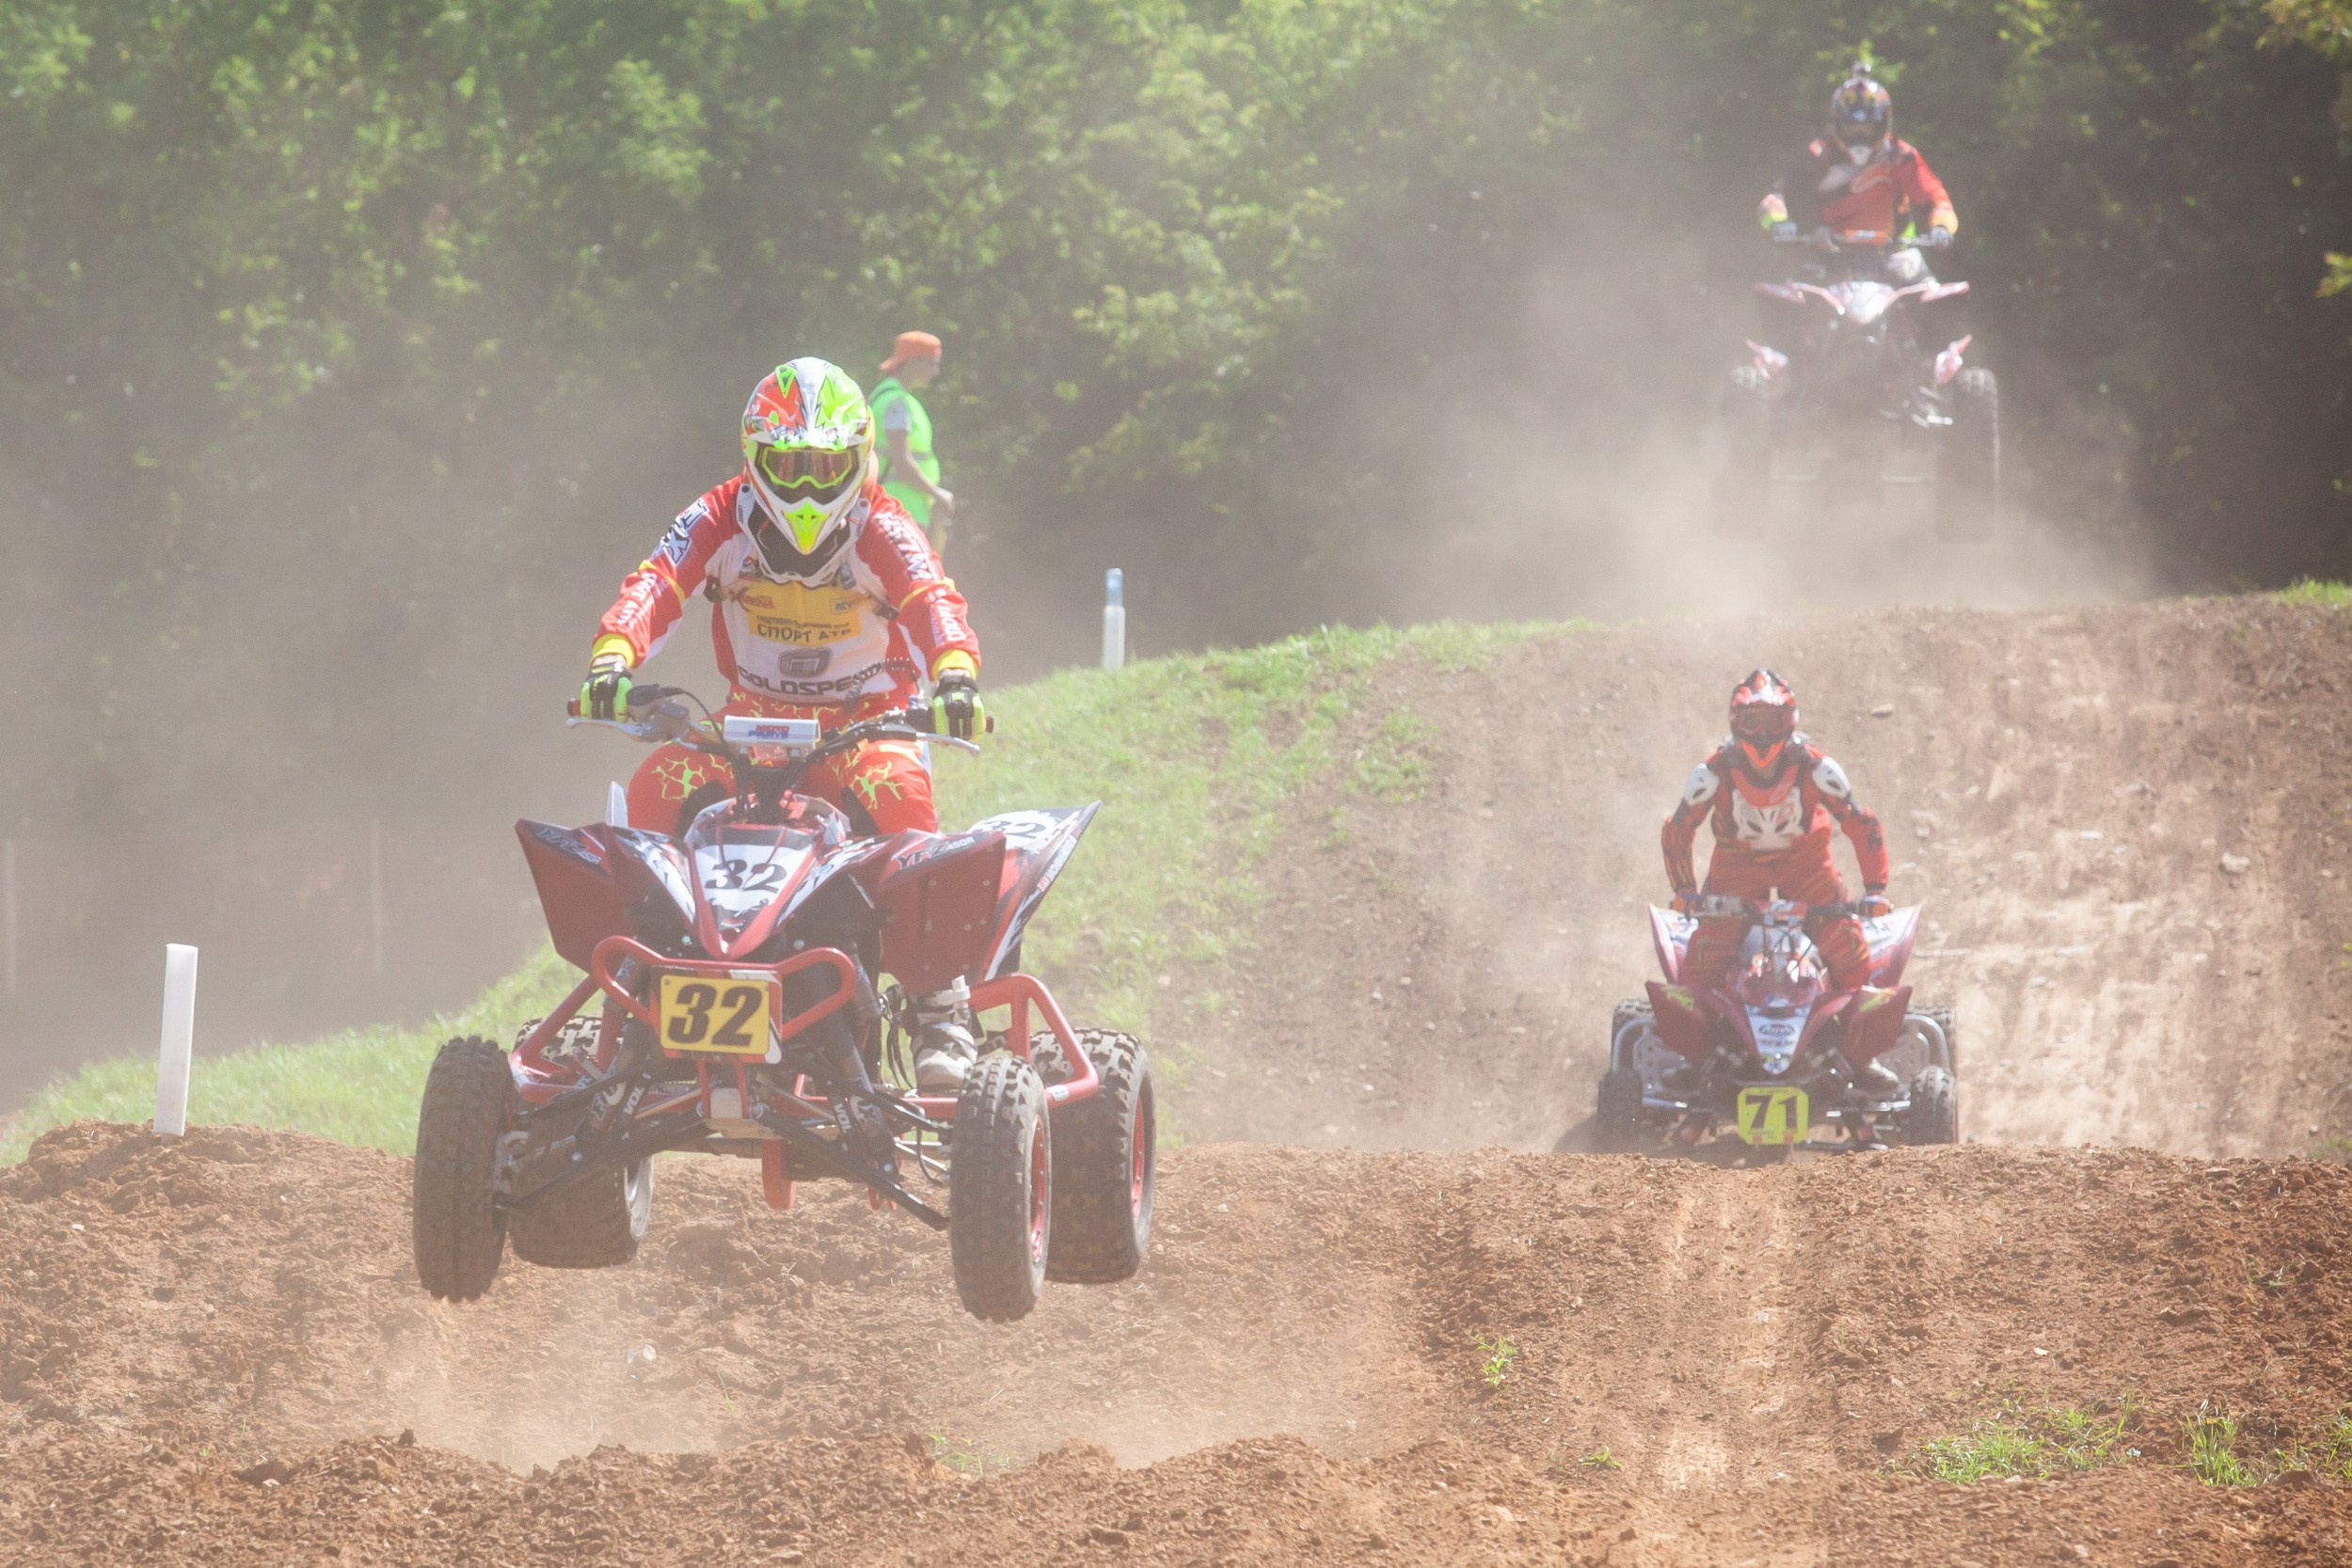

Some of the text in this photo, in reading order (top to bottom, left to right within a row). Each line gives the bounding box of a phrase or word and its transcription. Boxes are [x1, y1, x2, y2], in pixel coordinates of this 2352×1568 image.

[757, 624, 812, 642] СПОРТ
[705, 859, 787, 894] 32
[667, 983, 763, 1047] 32
[1745, 1095, 1799, 1129] 71
